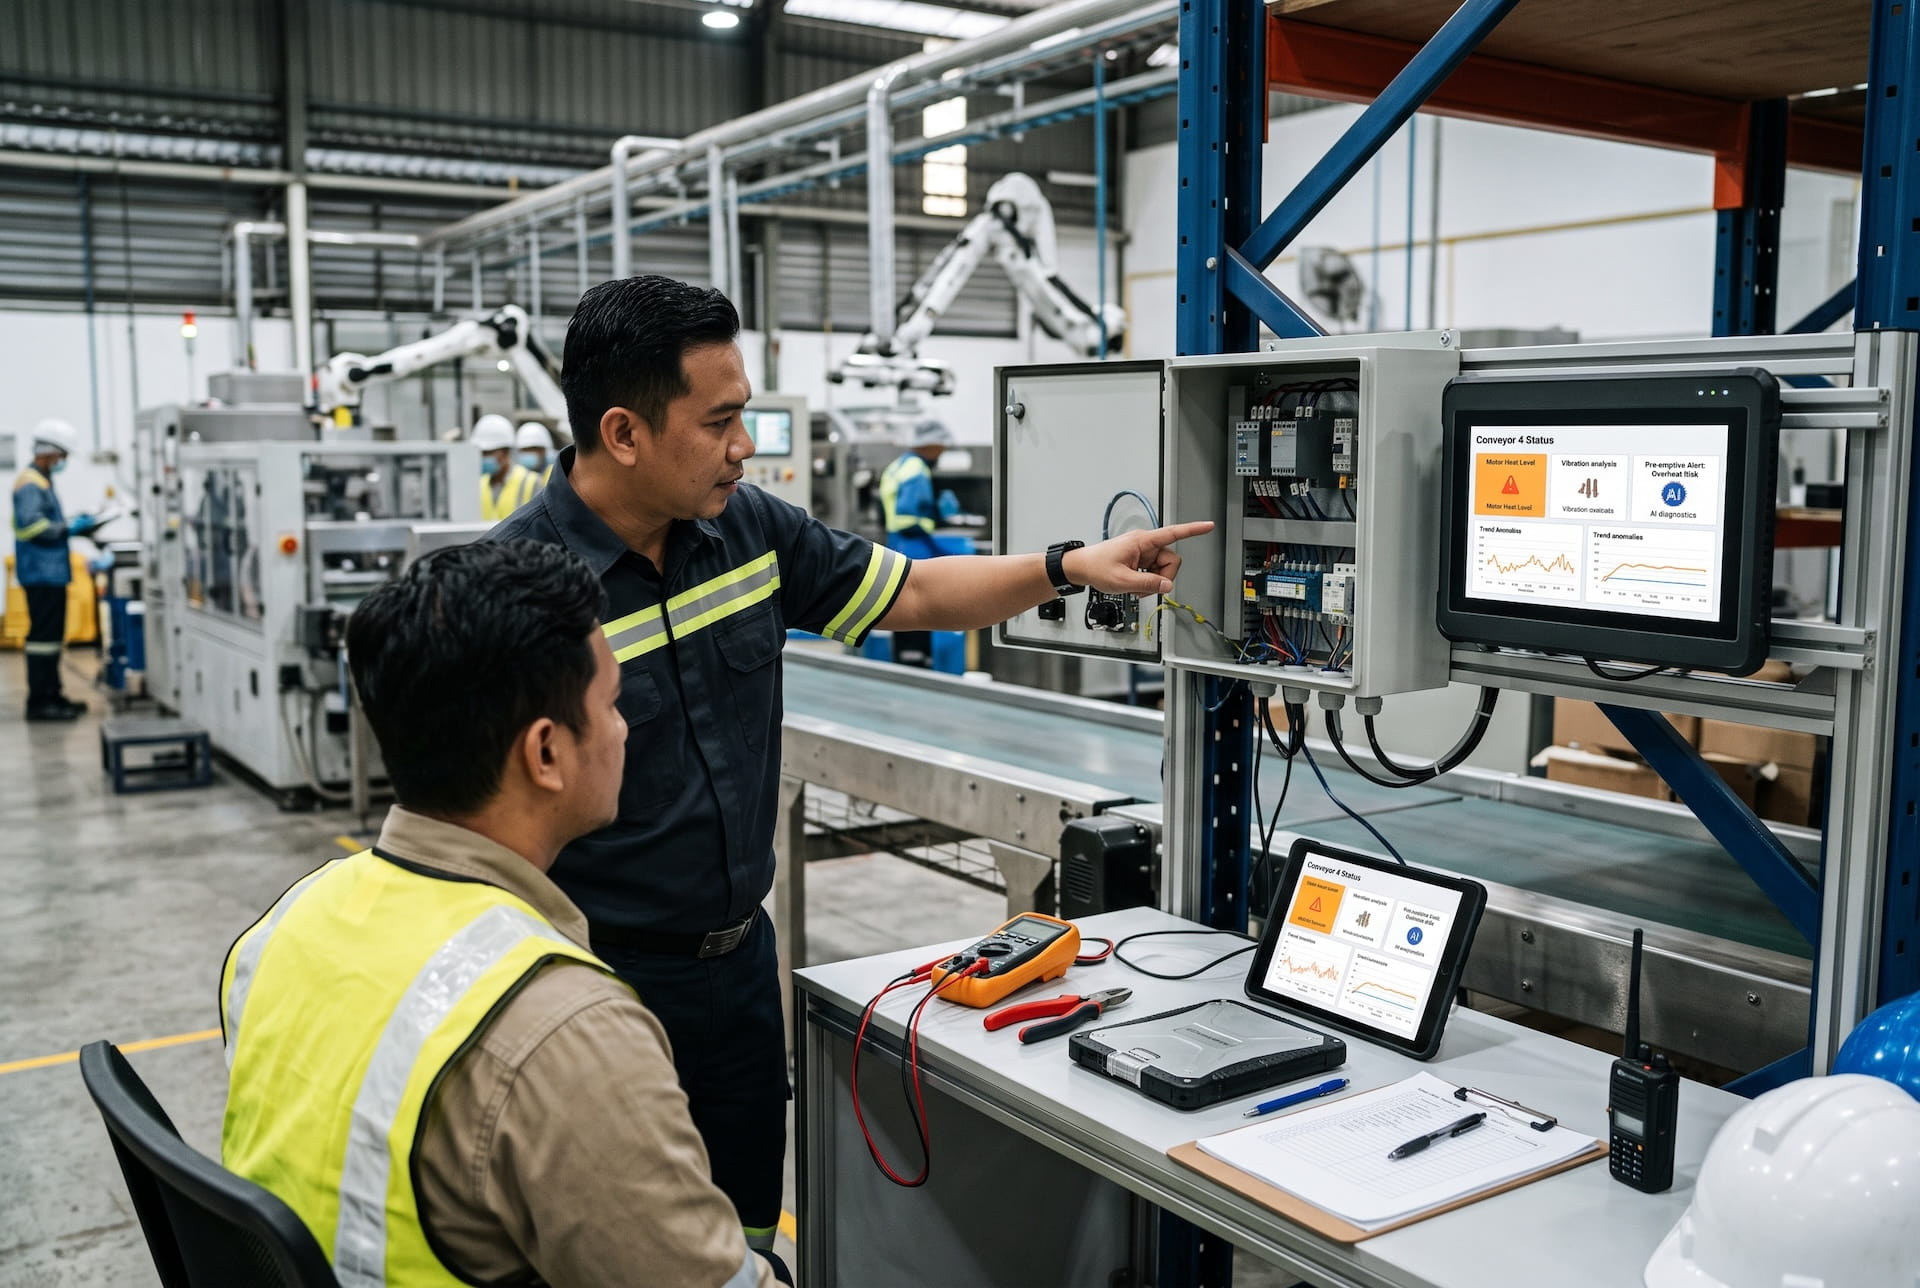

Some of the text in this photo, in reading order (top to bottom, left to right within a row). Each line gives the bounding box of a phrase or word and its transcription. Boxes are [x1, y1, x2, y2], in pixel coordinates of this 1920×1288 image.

[1476, 435, 1554, 446] Conveyor 4 Status
[1561, 459, 1617, 469] Vibration analysis
[1645, 461, 1686, 470] Pre-emptive
[1651, 470, 1682, 478] Overheat
[1665, 488, 1681, 501] AI
[1562, 505, 1588, 513] Vibration
[1658, 511, 1697, 519] diagnostics
[1612, 533, 1644, 541] anomalies
[1307, 861, 1336, 876] Conveyor
[1341, 870, 1362, 882] Status
